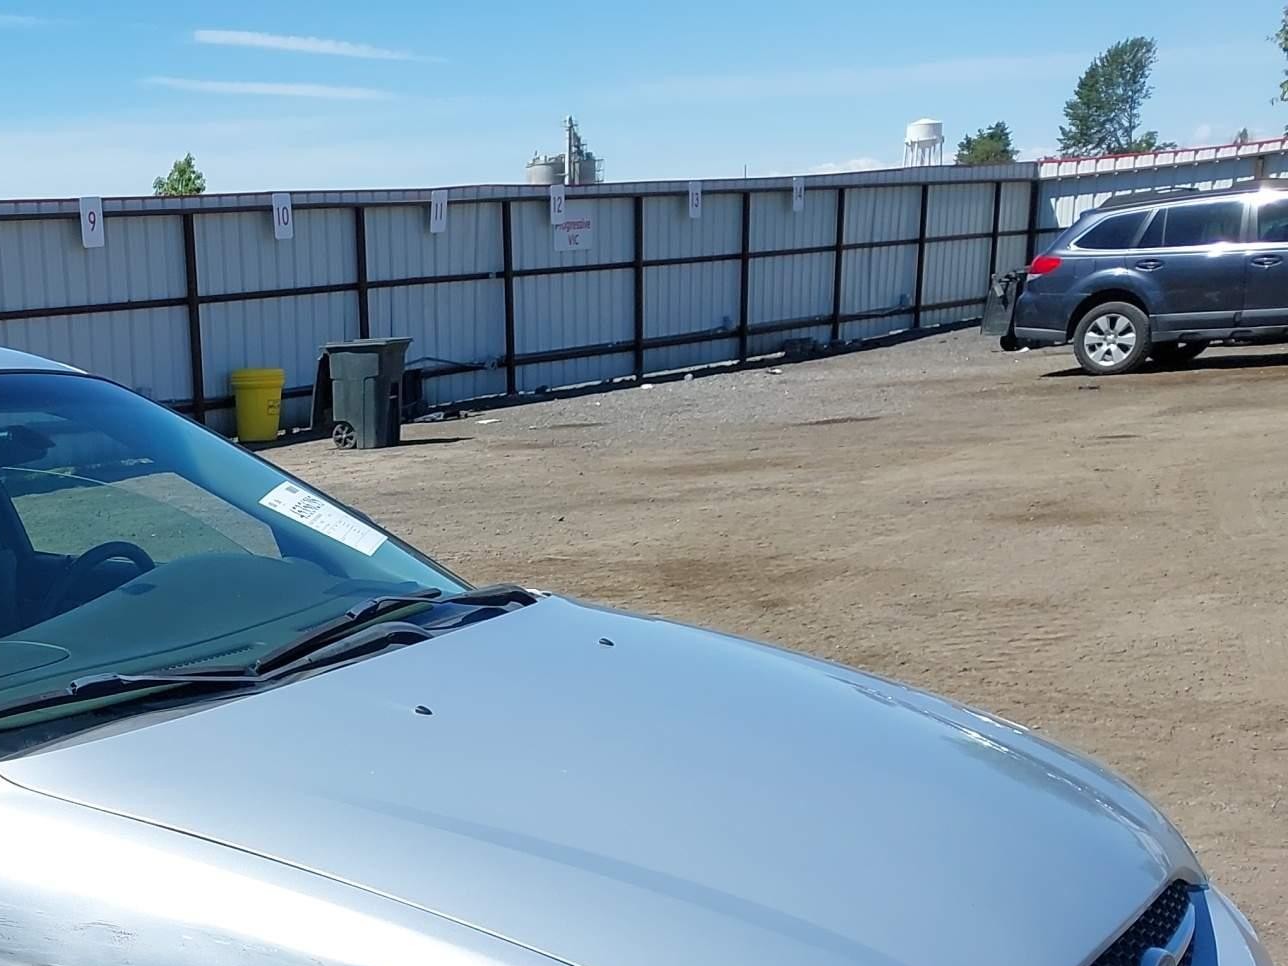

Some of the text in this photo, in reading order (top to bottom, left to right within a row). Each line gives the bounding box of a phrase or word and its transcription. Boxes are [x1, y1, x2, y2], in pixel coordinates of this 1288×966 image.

[435, 203, 443, 221] 11
[553, 196, 562, 213] 12
[87, 211, 97, 232] 9
[277, 207, 289, 226] 10
